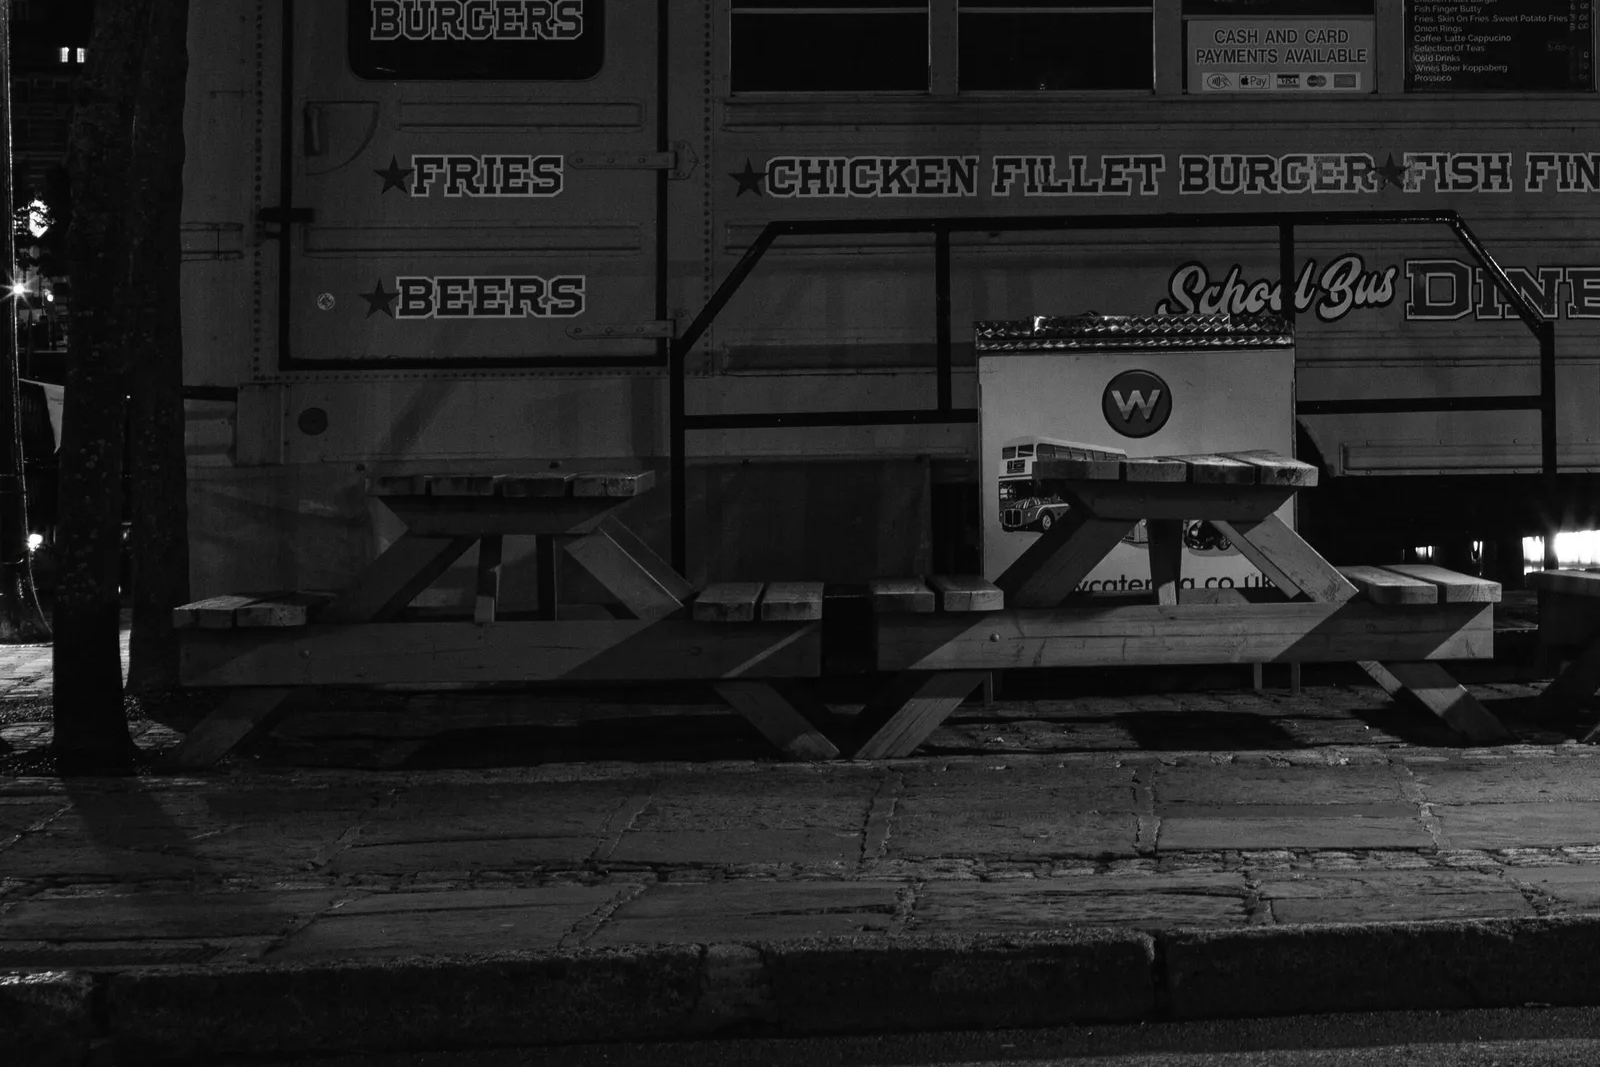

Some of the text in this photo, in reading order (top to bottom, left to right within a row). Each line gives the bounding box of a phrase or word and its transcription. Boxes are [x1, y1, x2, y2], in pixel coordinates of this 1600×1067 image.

[1413, 5, 1430, 13] Fish
[1432, 5, 1458, 14] Finger
[1459, 5, 1482, 14] Butty
[1437, 14, 1454, 23] Skin
[1456, 14, 1468, 23] On
[1520, 14, 1547, 22] Potato
[1548, 14, 1568, 22] Fries
[1414, 25, 1438, 33] Onion
[1439, 25, 1463, 34] Rings
[1213, 29, 1349, 44] CASH AND CARD
[1414, 34, 1512, 43] Coffee Latte Cappucino
[1414, 44, 1485, 52] Selection Of Teas
[1196, 48, 1367, 64] PAYMENTS AVAILABLE
[1414, 54, 1460, 62] Cold Drinks
[1414, 64, 1440, 72] Wines
[1441, 64, 1461, 72] Beer
[1250, 76, 1267, 88] Pay
[411, 154, 564, 197] FRIES
[765, 155, 979, 198] CHICKEN
[991, 154, 1165, 197] FILLET
[1178, 153, 1377, 196] BURGER
[1402, 152, 1513, 193] FISH
[1316, 253, 1399, 323] Bus
[395, 275, 586, 319] BEERS
[1112, 388, 1162, 424] W
